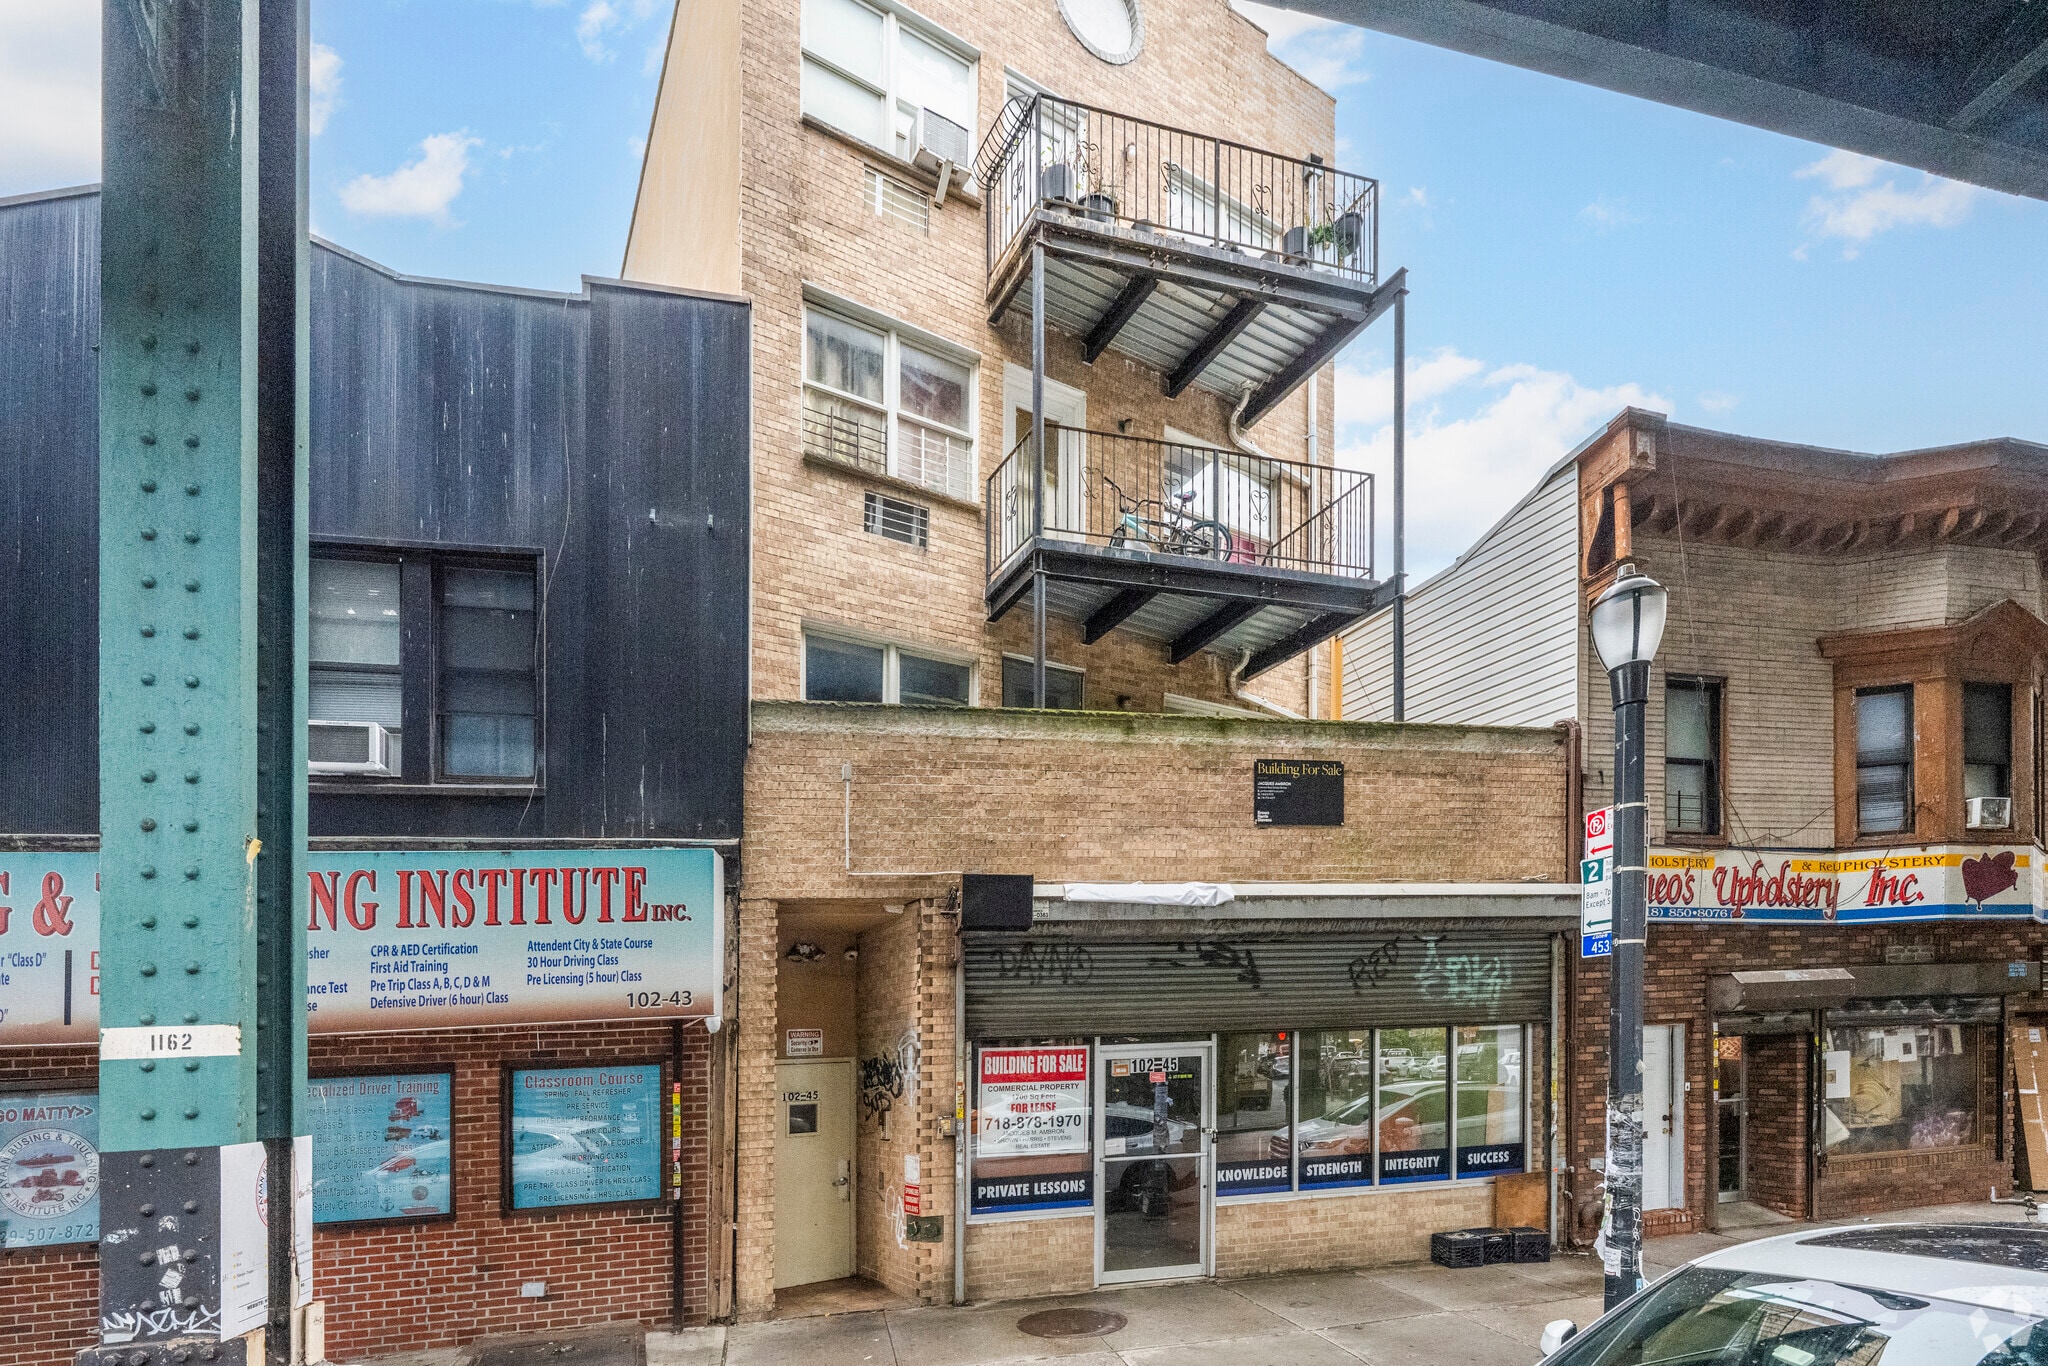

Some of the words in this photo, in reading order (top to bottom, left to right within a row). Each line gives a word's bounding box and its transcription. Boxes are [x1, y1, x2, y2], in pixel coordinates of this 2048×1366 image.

[1257, 762, 1300, 778] Building
[1302, 763, 1320, 776] For
[1321, 763, 1342, 776] Sale
[1587, 861, 1599, 882] 2
[1801, 861, 1812, 871] &
[1586, 891, 1599, 900] 8am
[1712, 859, 1841, 920] Upholstery
[1863, 866, 1924, 907] Inc.
[33, 871, 74, 937] &
[396, 867, 648, 929] INSTITUTE
[651, 903, 692, 922] INC.
[1586, 899, 1606, 909] Except
[370, 945, 389, 957] CPR
[391, 945, 399, 956] &
[400, 944, 420, 956] AED
[422, 942, 478, 956] Certification
[527, 939, 572, 952] Attendent
[573, 938, 590, 953] City
[592, 938, 599, 950] &
[600, 938, 622, 950] State
[624, 937, 653, 949] Course
[1591, 939, 1611, 954] 453
[370, 961, 391, 974] First
[393, 960, 409, 973] Aid
[410, 960, 448, 974] Training
[527, 957, 538, 968] 30
[540, 956, 561, 968] Hour
[563, 955, 595, 969] Driving
[597, 953, 619, 966] Class
[370, 979, 386, 991] Pre
[387, 979, 405, 993] Trip
[407, 977, 431, 990] Class
[433, 977, 442, 991] A,
[443, 977, 452, 991] B,
[453, 976, 462, 990] C,
[463, 976, 471, 988] D
[472, 976, 480, 988] &
[481, 975, 490, 987] M
[527, 973, 541, 985] Pre
[543, 972, 584, 987] Licensing
[585, 971, 594, 984] (5
[596, 970, 619, 984] hour)
[620, 969, 642, 982] Class
[328, 981, 348, 994] Test
[370, 996, 416, 1009] Defensive
[418, 994, 446, 1008] Driver
[449, 993, 458, 1007] (6
[459, 992, 484, 1006] hour)
[486, 991, 509, 1004] Class
[626, 990, 693, 1008] 102-43
[151, 1033, 192, 1051] 1162
[984, 1055, 1035, 1075] BUILDING
[1037, 1054, 1057, 1074] FOR
[1058, 1053, 1084, 1073] SALE
[360, 1081, 392, 1096] Driver
[396, 1079, 440, 1095] Training
[525, 1075, 594, 1089] Classroom
[599, 1072, 643, 1086] Course
[987, 1084, 1038, 1092] COMMERCIAL
[1039, 1082, 1080, 1091] PROPERTY
[544, 1090, 569, 1099] SPRING
[574, 1089, 591, 1097] FALL
[593, 1088, 631, 1096] REFRESHER
[782, 1090, 819, 1102] 102-45
[582, 1101, 609, 1109] SERVICE
[1010, 1103, 1028, 1113] FOR
[1030, 1102, 1057, 1112] LEASE
[985, 1115, 1082, 1131] 718-878-1970
[617, 1138, 644, 1147] COURSE
[8, 1132, 51, 1156] BUSING
[55, 1133, 63, 1141] &
[67, 1136, 97, 1183] TRUCKING
[606, 1151, 628, 1160] CLASS
[545, 1168, 559, 1176] CPR
[582, 1164, 631, 1174] CERTIFICATION
[1217, 1165, 1288, 1183] KNOWLEDGE
[1306, 1160, 1362, 1177] STRENGTH
[1384, 1155, 1440, 1171] INTEGRITY
[1467, 1150, 1510, 1165] SUCCESS
[539, 1182, 555, 1190] TRIP
[556, 1180, 578, 1189] CLASS
[579, 1178, 604, 1188] DRIVER
[630, 1175, 651, 1183] CLASS
[977, 1183, 1030, 1200] PRIVATE
[1033, 1179, 1086, 1196] LESSONS
[10, 1197, 66, 1215] INSTITUTE
[68, 1192, 86, 1209] INC
[538, 1194, 552, 1202] PRE
[554, 1192, 590, 1201] LICENSING
[616, 1189, 638, 1197] CLASS
[312, 1201, 336, 1213] Safety
